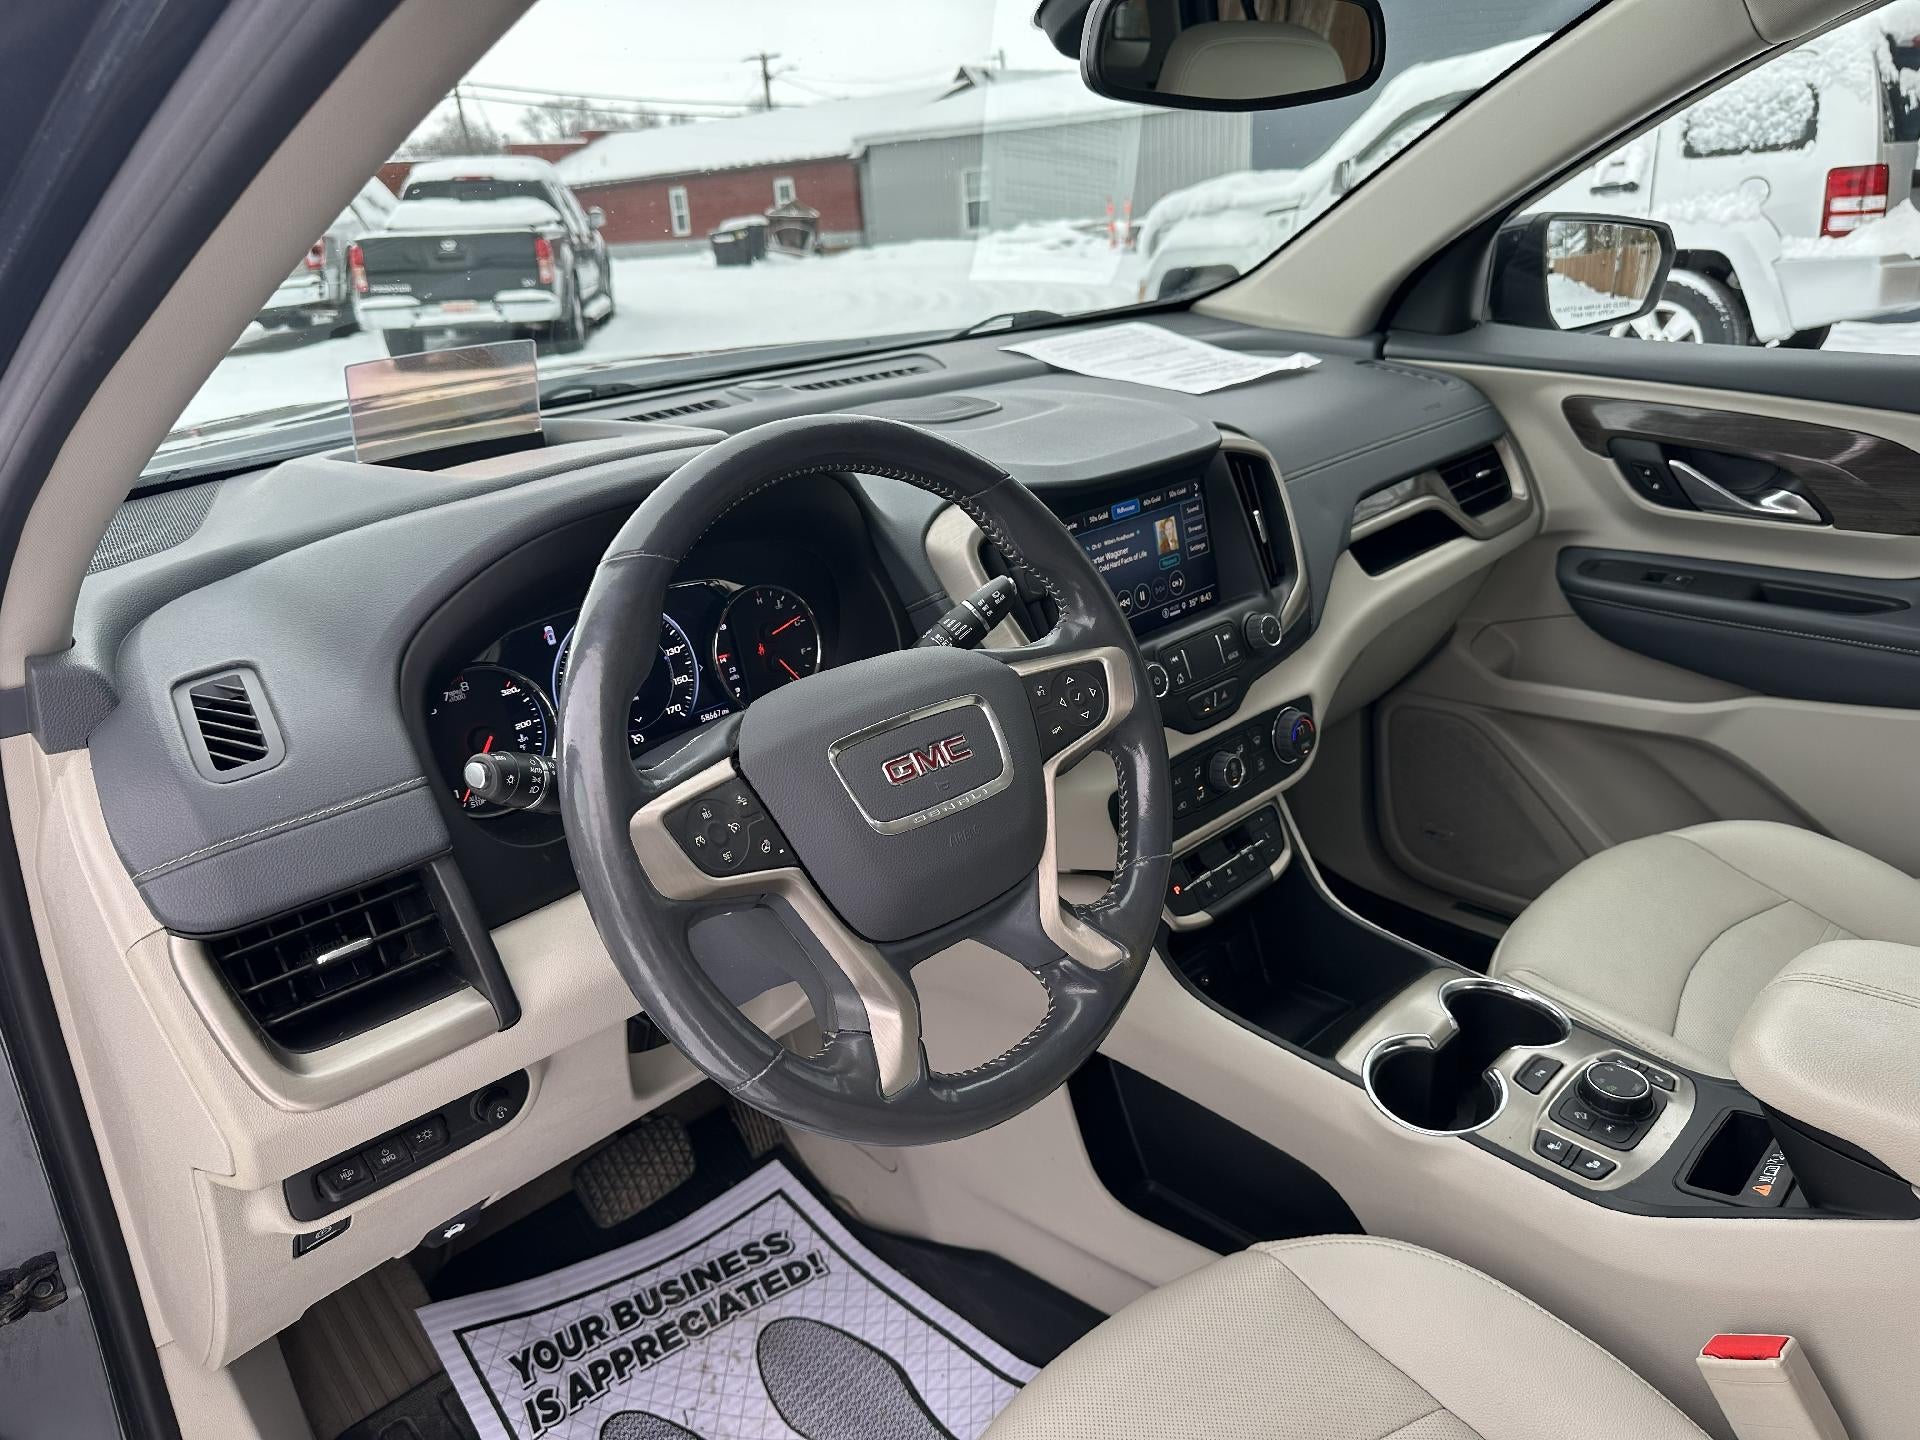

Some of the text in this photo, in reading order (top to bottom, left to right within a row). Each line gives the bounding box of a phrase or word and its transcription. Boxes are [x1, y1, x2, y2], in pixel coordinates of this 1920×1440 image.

[1104, 547, 1129, 561] Wagoner
[1109, 559, 1121, 568] Hard
[1138, 550, 1148, 559] Life
[665, 646, 681, 656] 130
[673, 674, 688, 686] 150
[460, 681, 470, 692] 8
[500, 686, 518, 697] 320
[666, 703, 682, 715] 170
[700, 709, 721, 723] 58667
[515, 719, 532, 731] 200
[881, 733, 974, 786] GMC
[914, 788, 988, 824] DENALI
[1173, 885, 1182, 896] P
[381, 1153, 397, 1165] INFO
[505, 1231, 795, 1388] YOUR BUSINESS
[524, 1250, 829, 1438] IS APPRECIATED!
